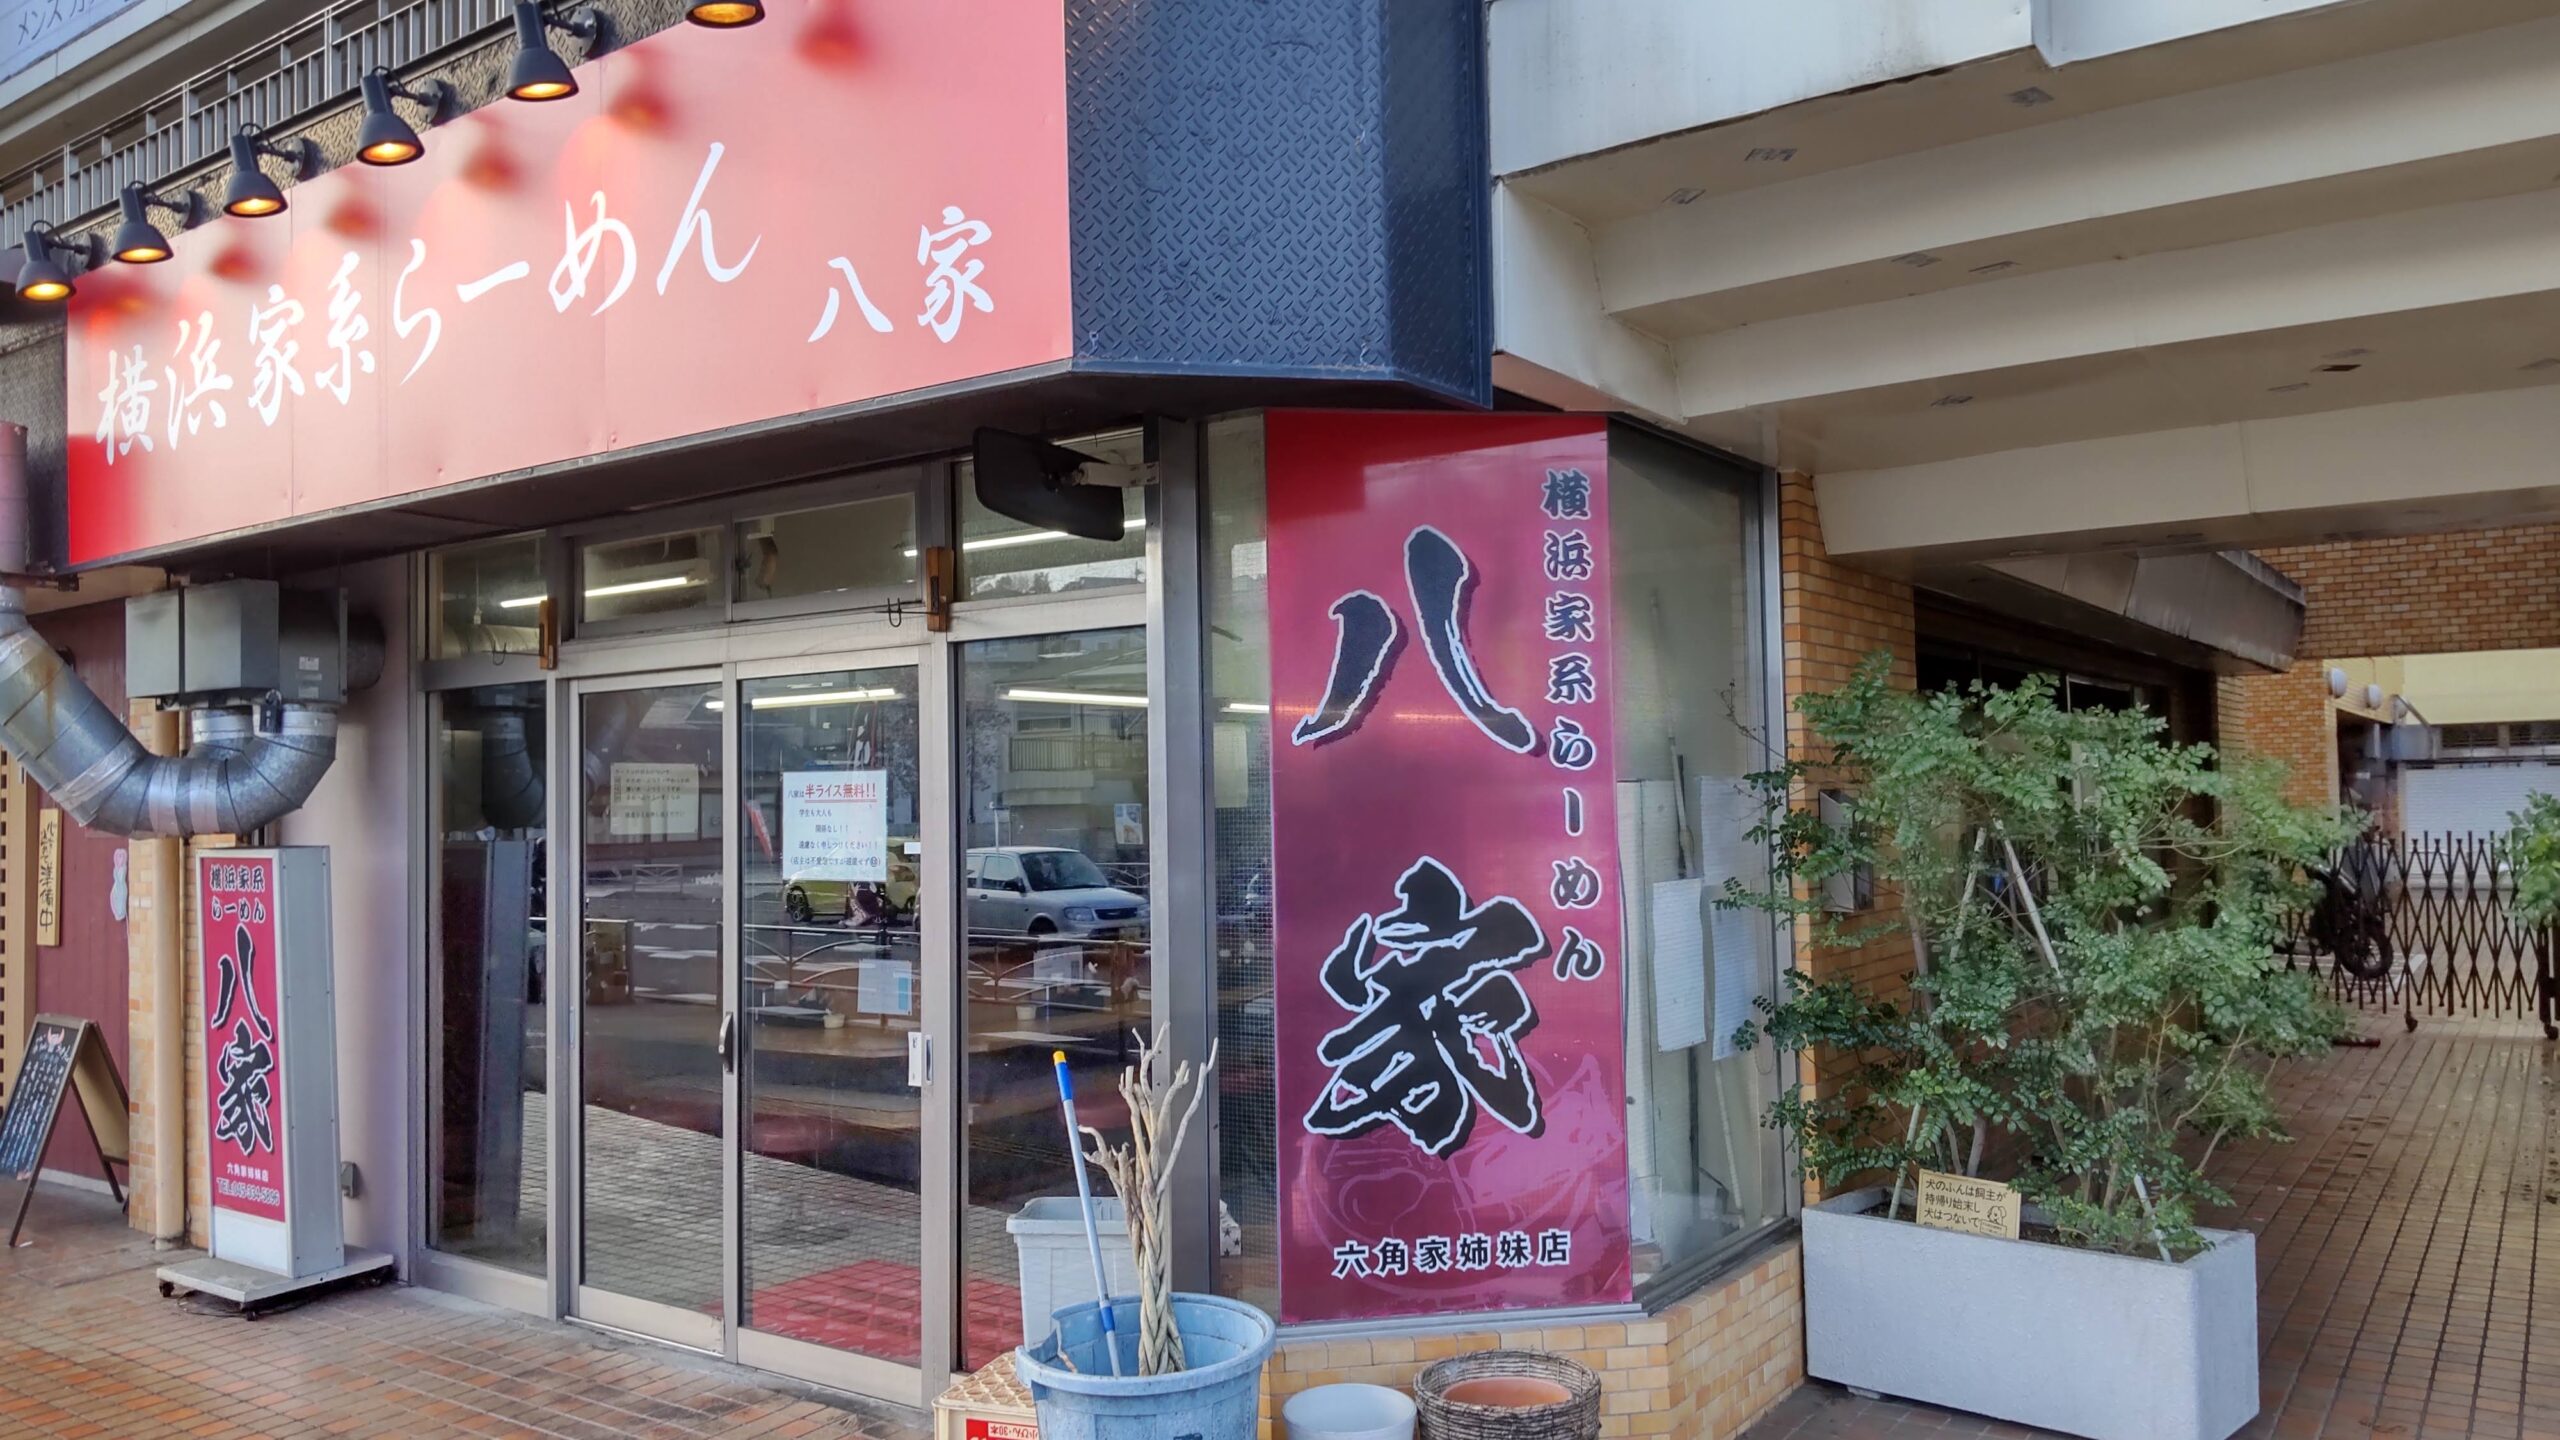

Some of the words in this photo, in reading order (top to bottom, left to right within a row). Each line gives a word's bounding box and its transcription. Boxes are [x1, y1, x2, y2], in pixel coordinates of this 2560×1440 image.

[95, 142, 762, 466] 横浜家系らーめん
[808, 205, 994, 343] 八家
[1542, 468, 1604, 983] 横浜家系らーめん
[210, 864, 266, 893] 横浜家系
[211, 895, 266, 924] らーめん
[1292, 525, 1545, 1157] 八家
[211, 923, 274, 1156] 八家
[1332, 1229, 1572, 1279] 六角家姉妹店
[1925, 1178, 2008, 1202] 犬のふんは飼主が
